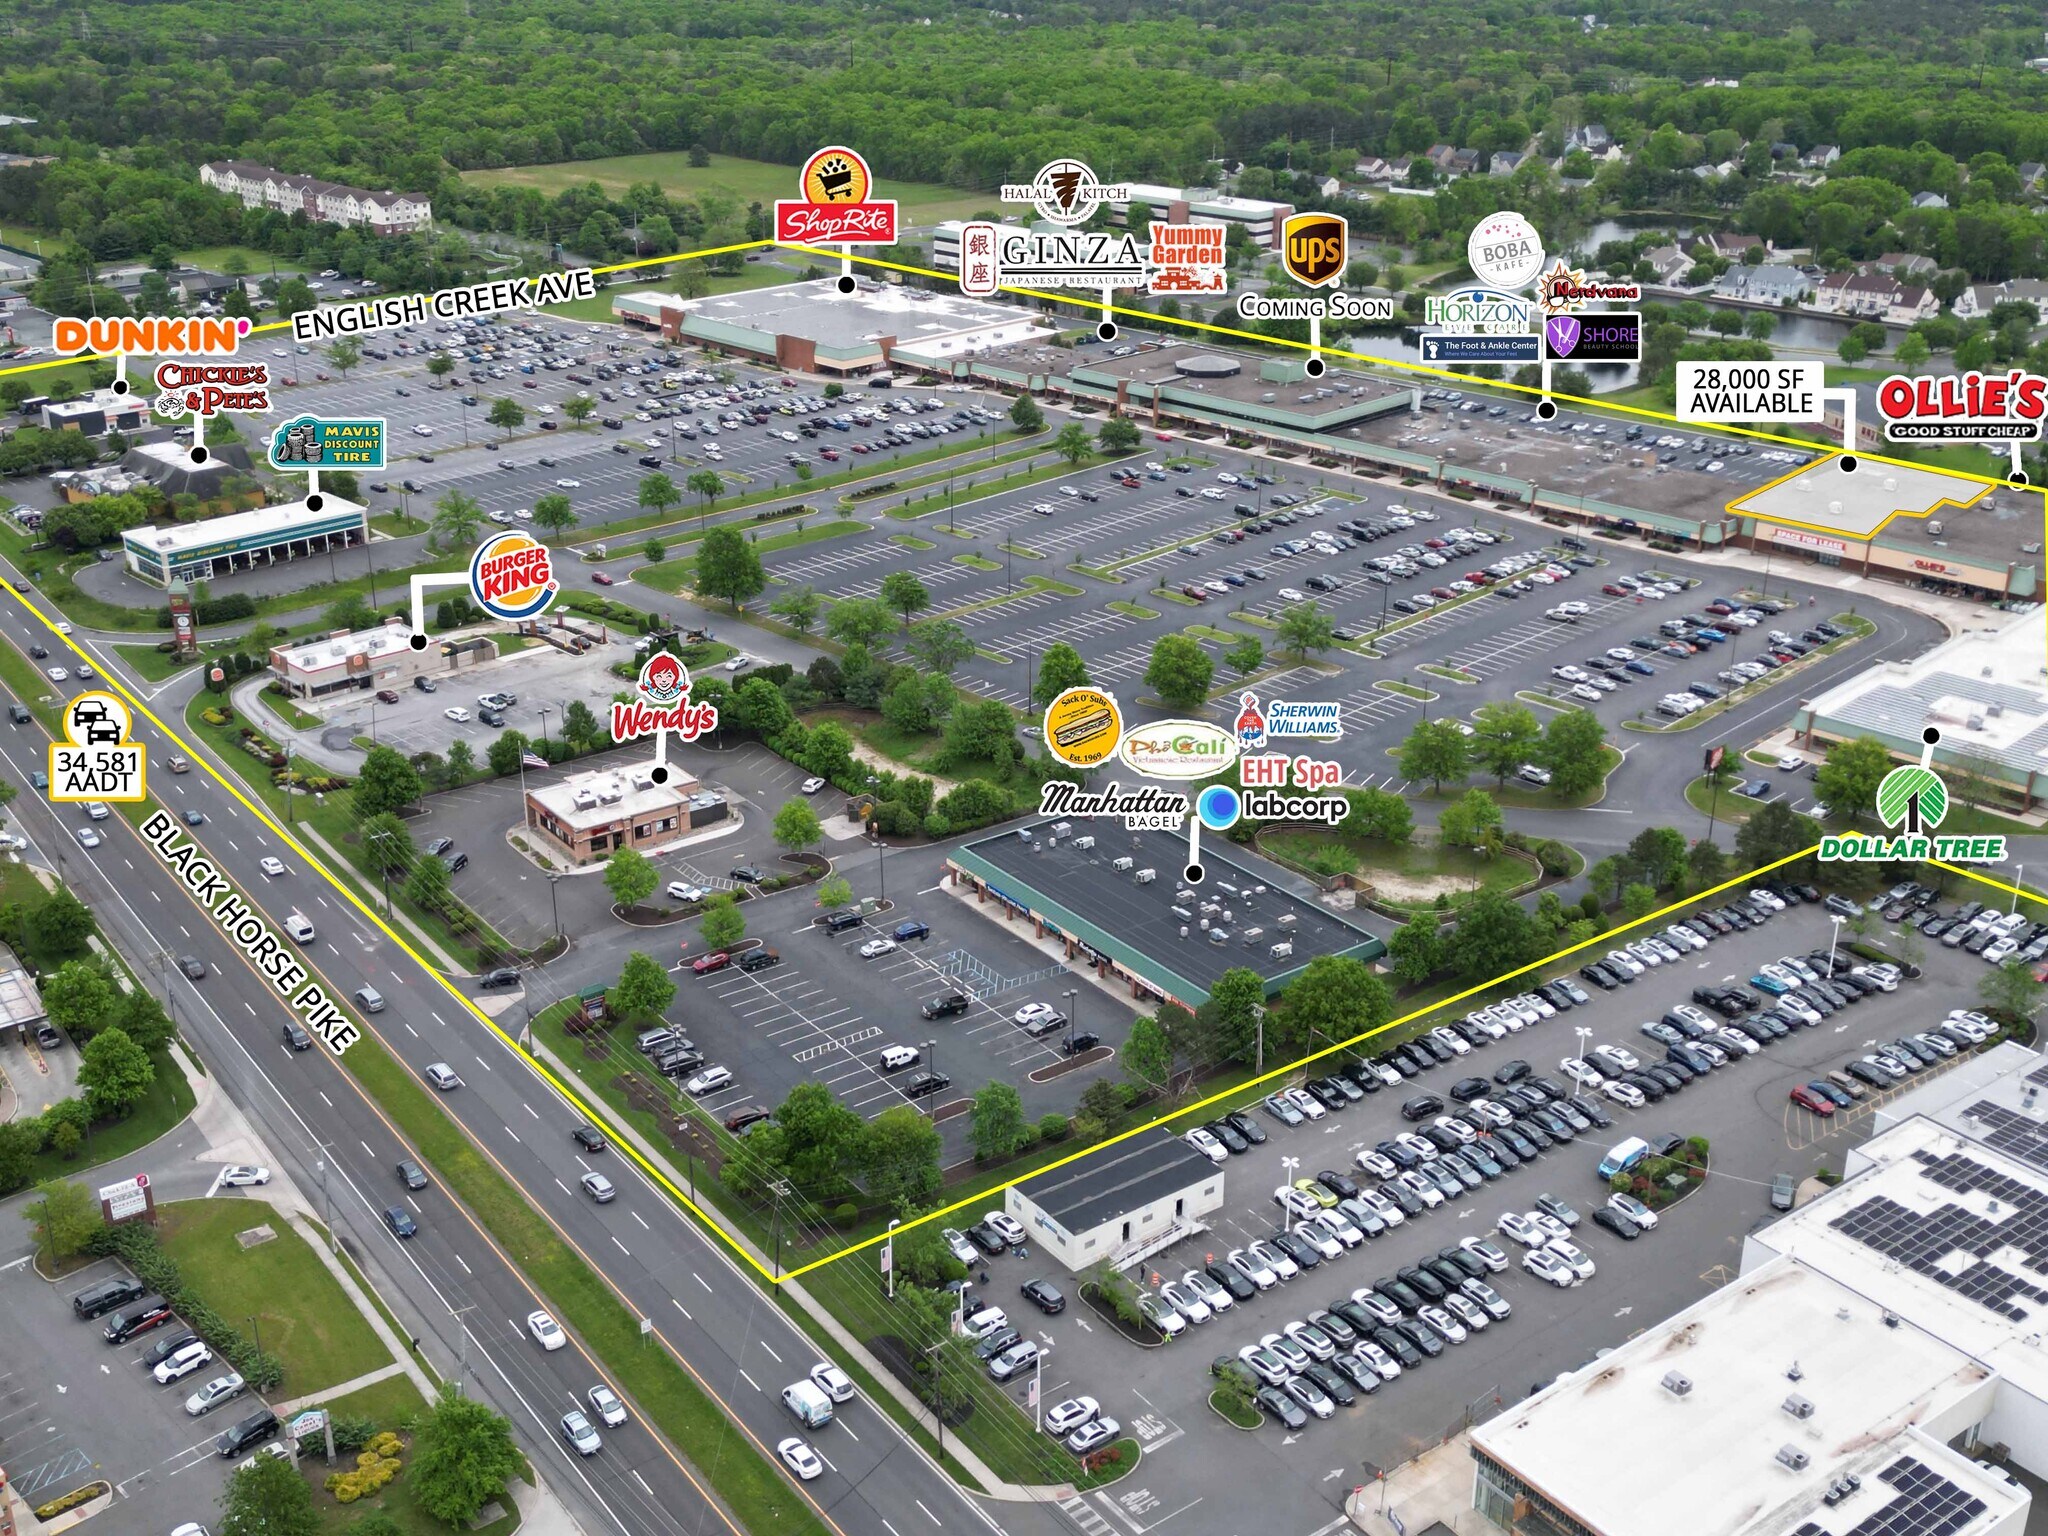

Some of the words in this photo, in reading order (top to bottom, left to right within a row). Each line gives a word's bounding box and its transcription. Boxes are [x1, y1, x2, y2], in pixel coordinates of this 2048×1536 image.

[1777, 530, 1801, 541] SPACE
[1802, 535, 1818, 545] FOR
[1819, 539, 1844, 550] LEASE
